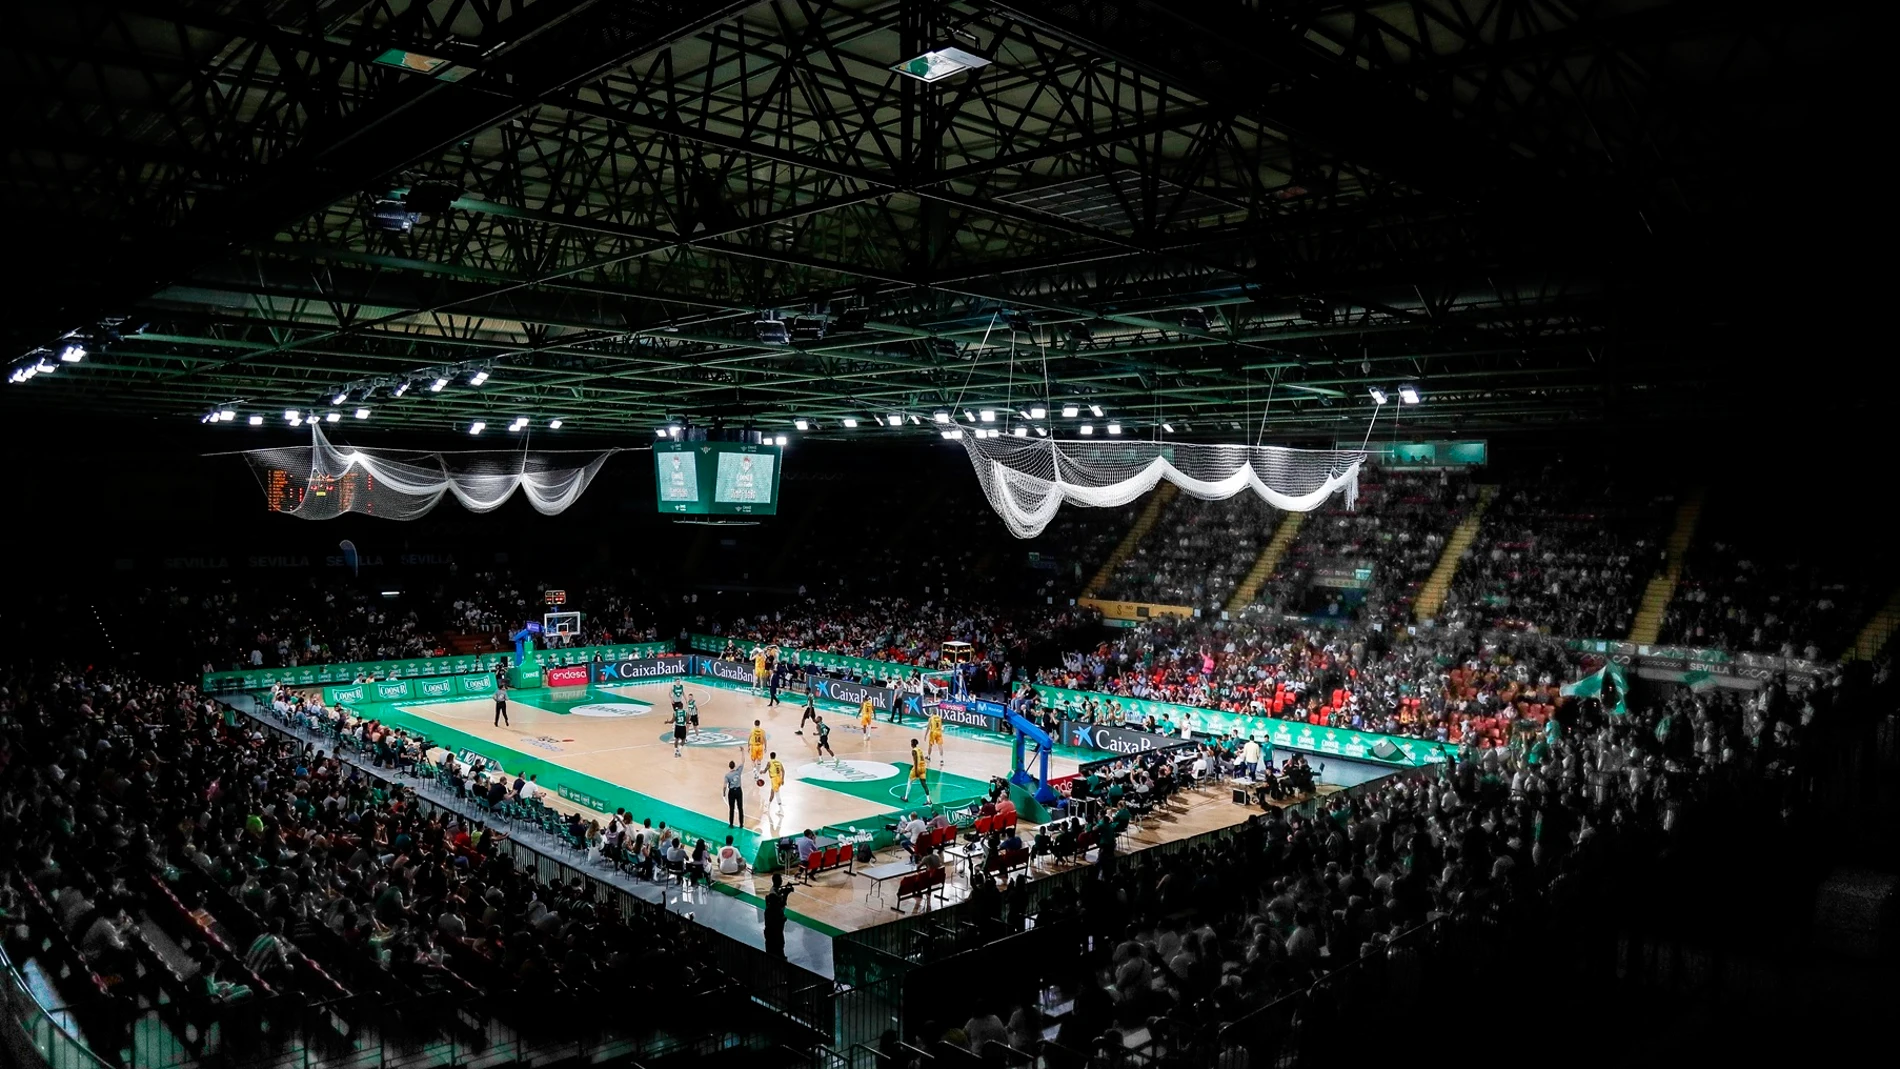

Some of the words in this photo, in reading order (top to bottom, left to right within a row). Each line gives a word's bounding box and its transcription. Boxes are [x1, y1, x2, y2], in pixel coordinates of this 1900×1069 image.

[163, 556, 229, 570] SEVILLA
[249, 554, 310, 568] SEVILLA
[401, 553, 453, 566] SEVILLA
[620, 660, 686, 678] CaixaBank
[1689, 662, 1730, 675] SEVILLA
[552, 671, 587, 681] endesa
[424, 682, 449, 692] COOSUR
[465, 678, 490, 689] COOSUR
[335, 689, 362, 702] COOSUR
[380, 685, 406, 697] COOSUR
